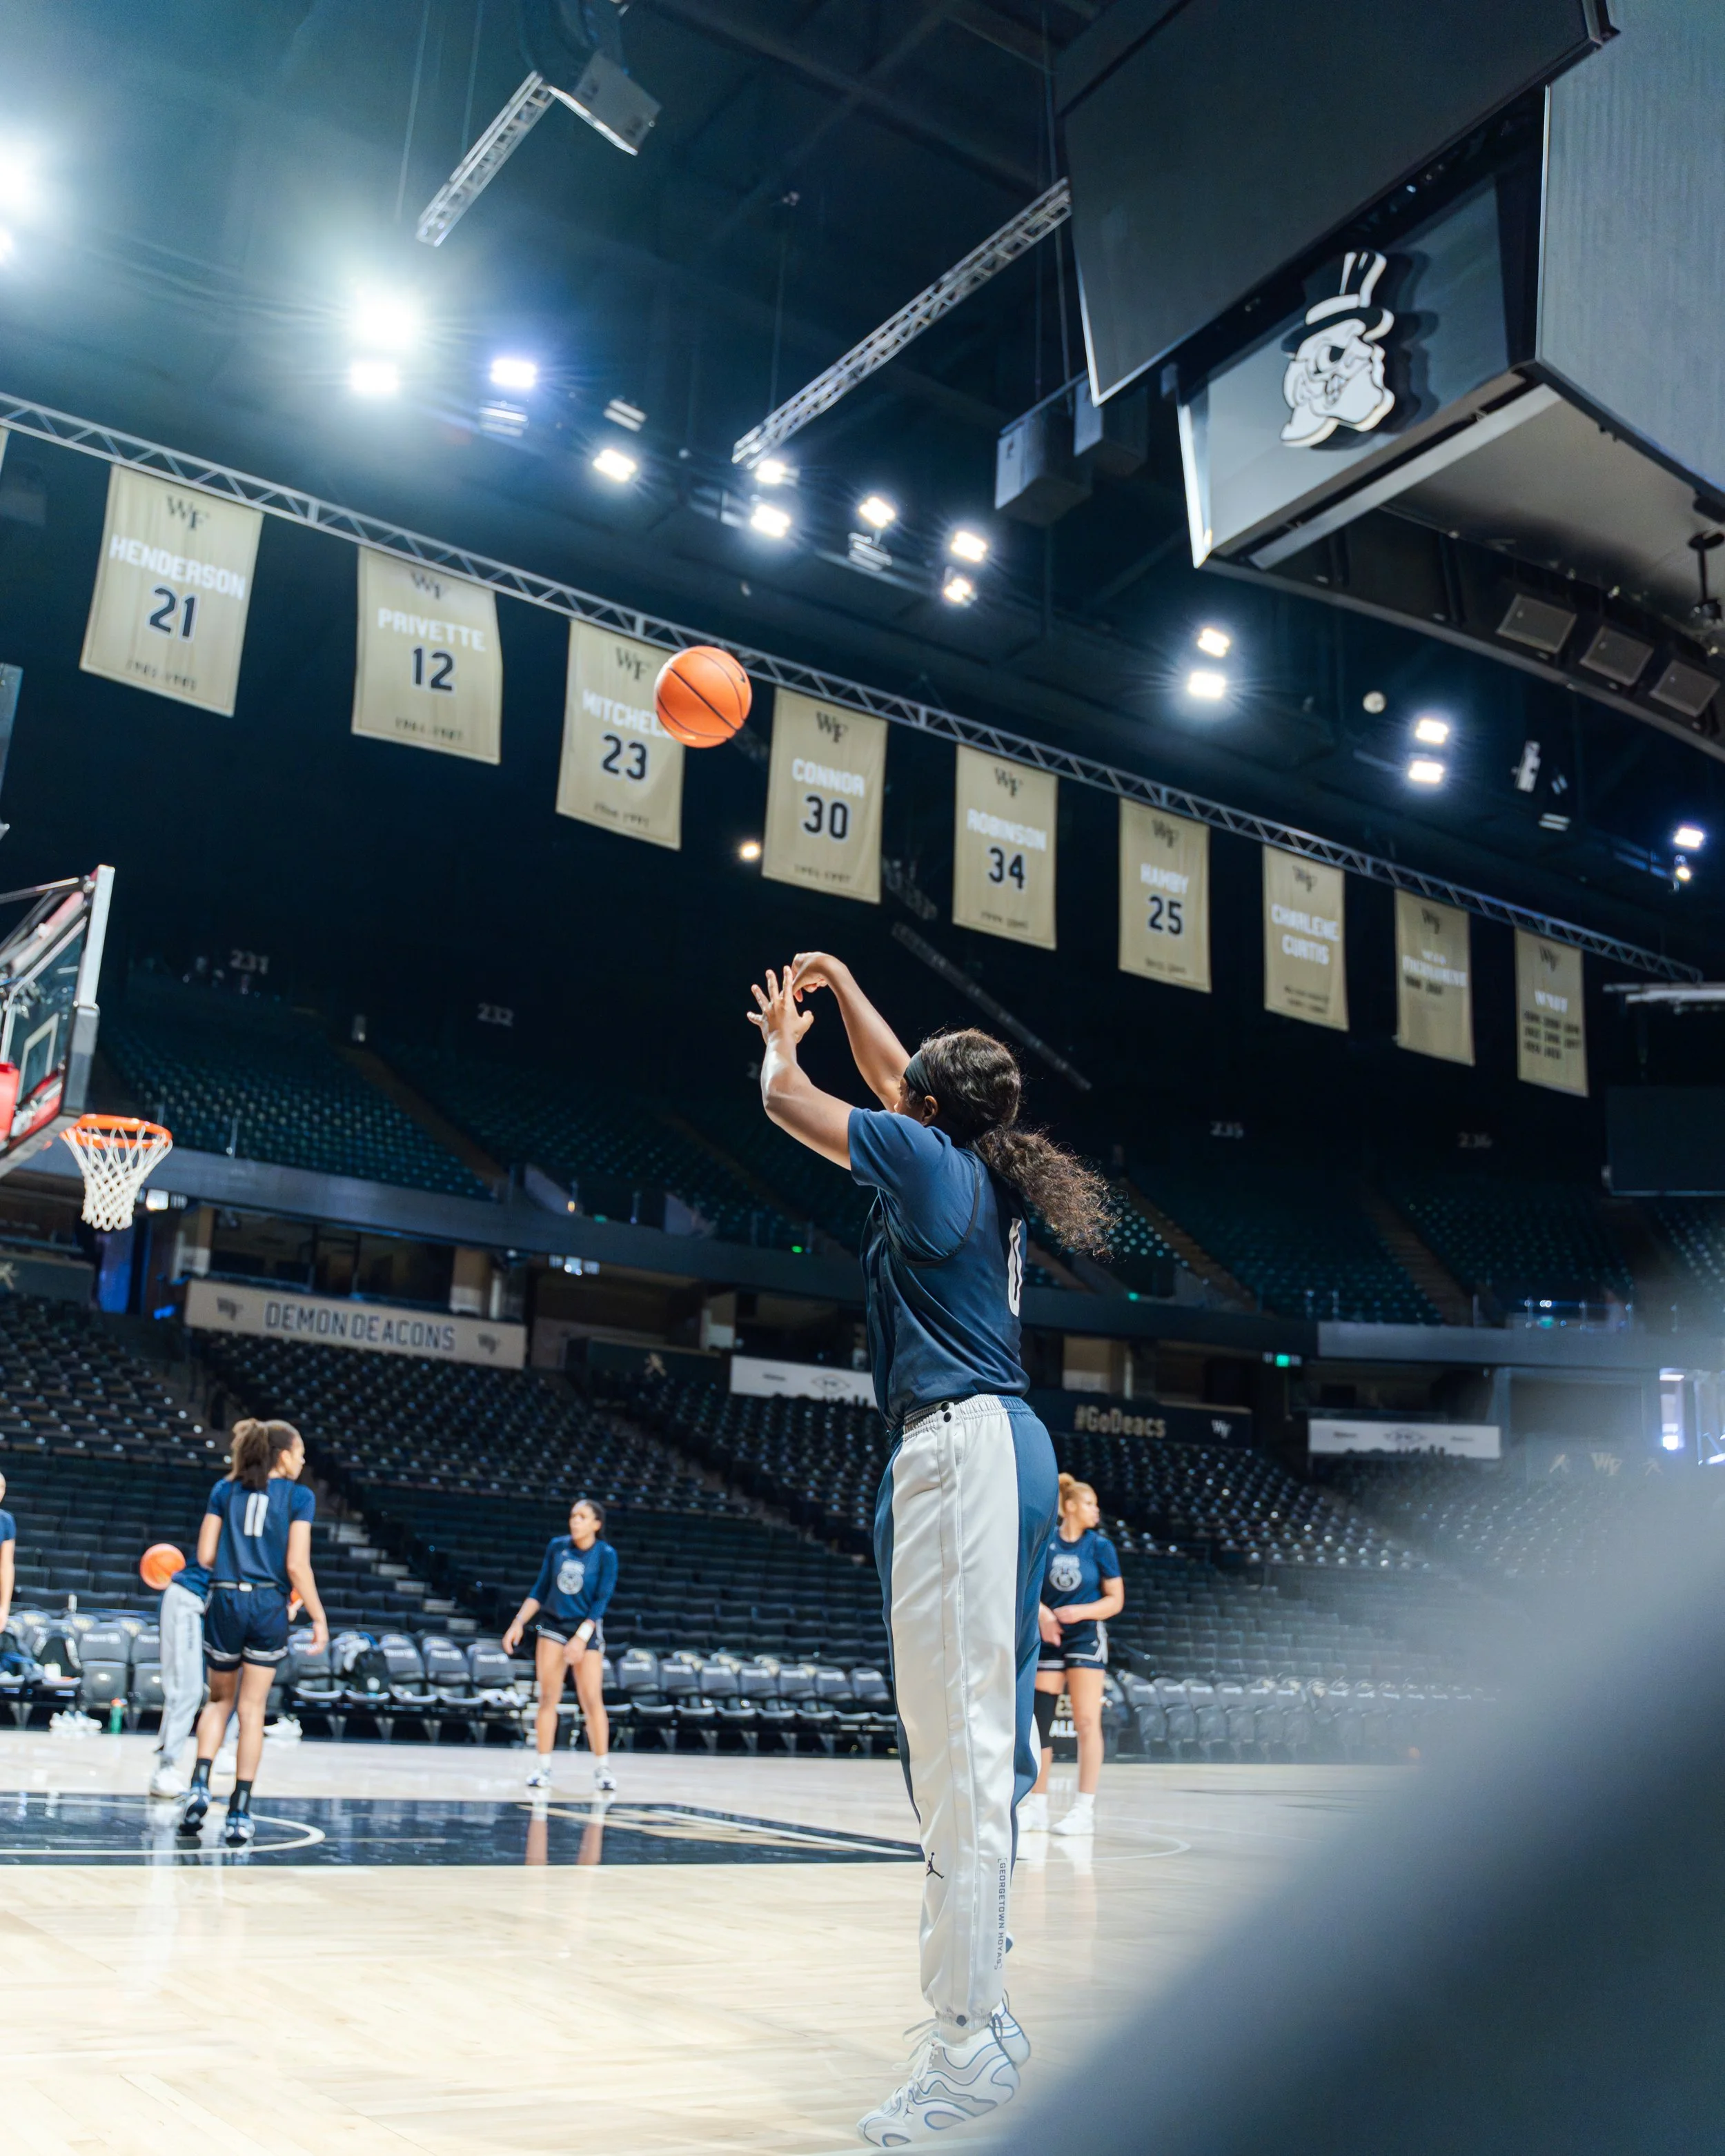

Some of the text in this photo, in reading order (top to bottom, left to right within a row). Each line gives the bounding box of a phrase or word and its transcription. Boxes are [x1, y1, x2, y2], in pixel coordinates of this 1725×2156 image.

[109, 534, 246, 602] HENDERSON
[147, 584, 198, 642] 21
[378, 606, 486, 652] PRIVETTE
[412, 645, 454, 693] 12
[582, 689, 672, 740] MITCHEL
[602, 732, 649, 782] 23
[791, 758, 865, 799] CONNOR
[802, 793, 851, 842] 30
[967, 808, 1047, 852] ROBINSON
[987, 845, 1027, 893] 34
[1148, 895, 1183, 936] 25
[1282, 934, 1330, 965] CURTIS
[264, 1298, 455, 1352] DEMON DEACONS
[1074, 1405, 1167, 1438] #GoDeacs
[244, 1493, 269, 1537] 11
